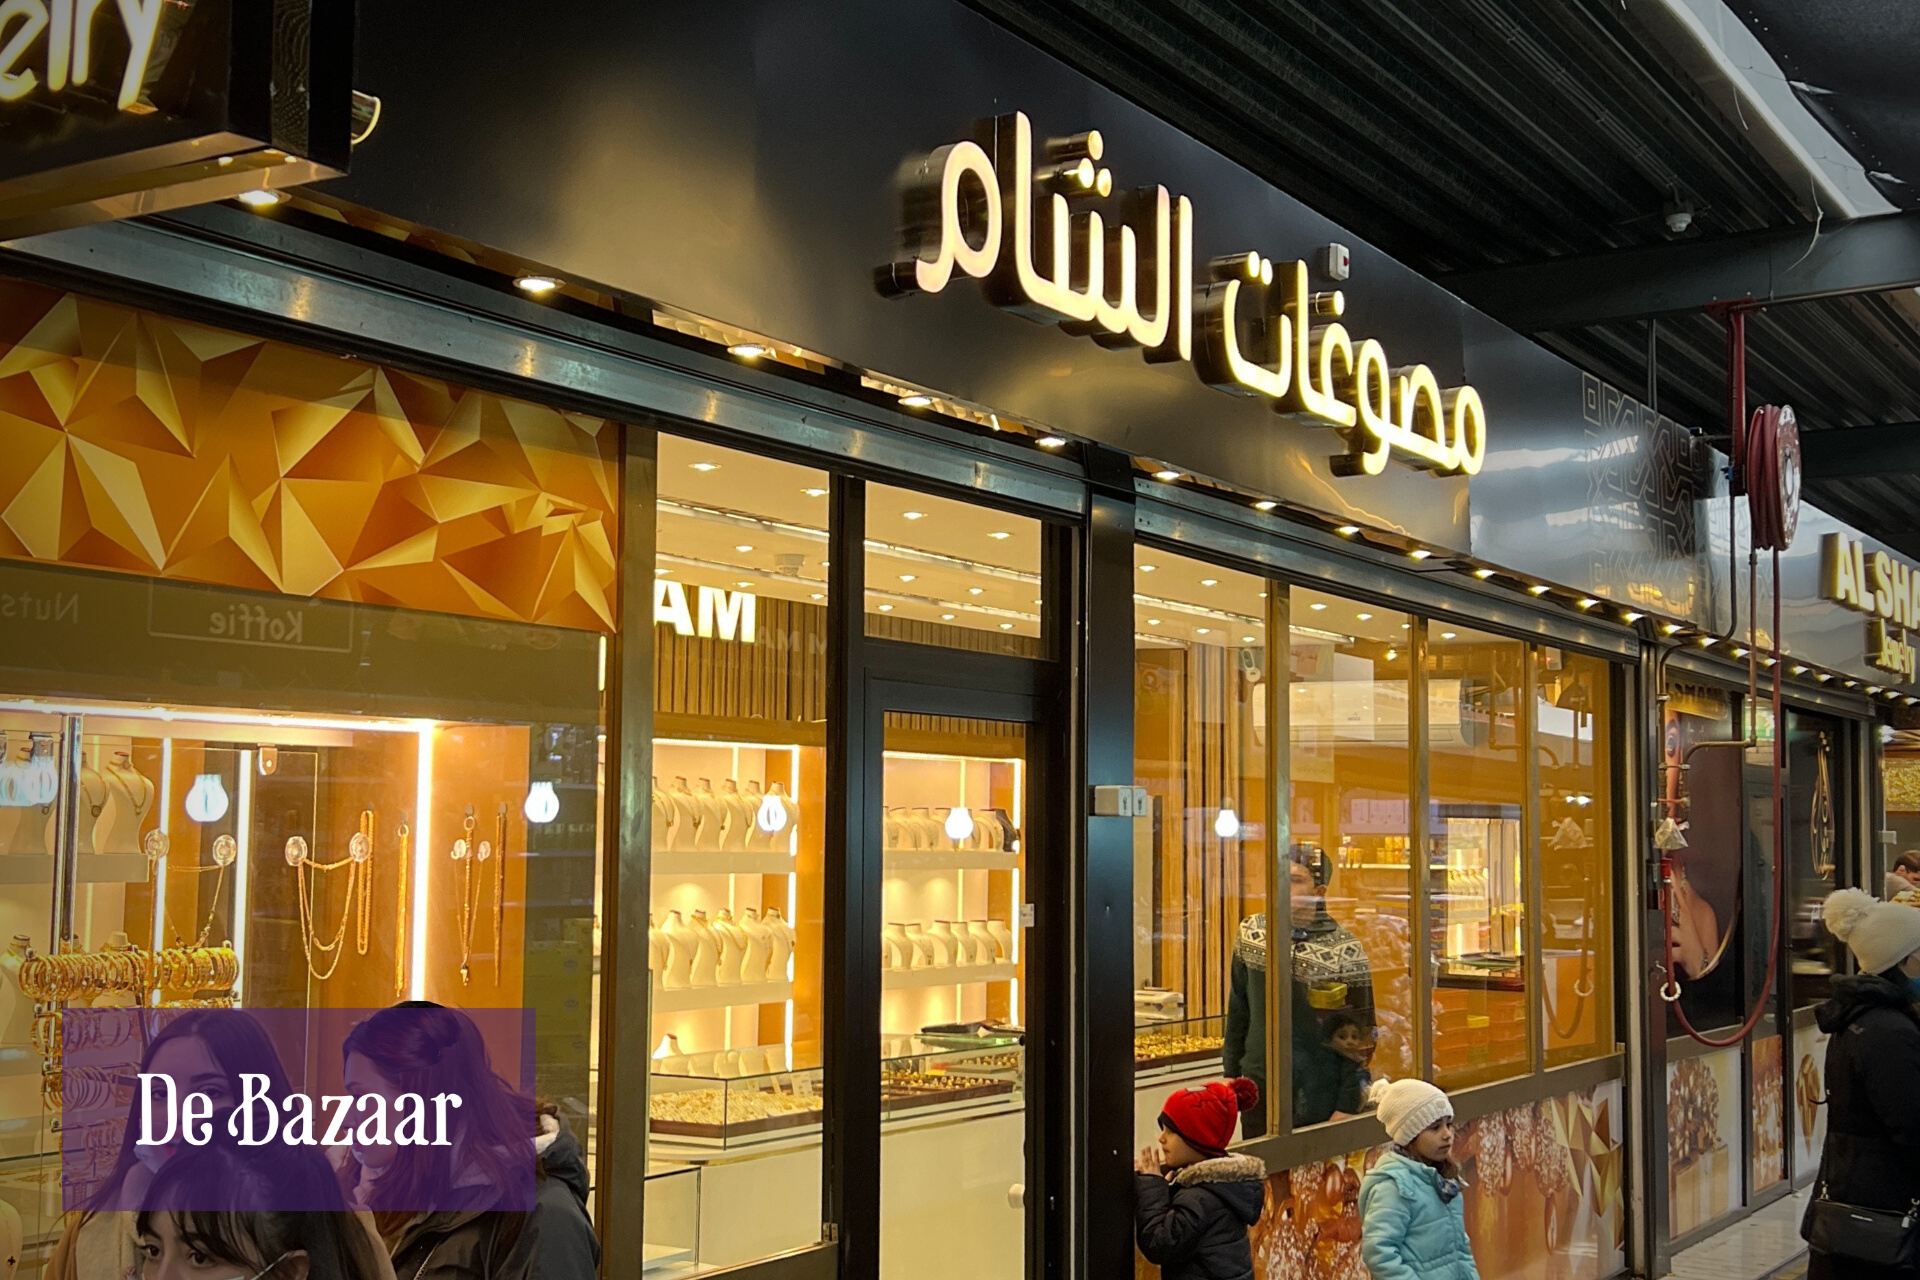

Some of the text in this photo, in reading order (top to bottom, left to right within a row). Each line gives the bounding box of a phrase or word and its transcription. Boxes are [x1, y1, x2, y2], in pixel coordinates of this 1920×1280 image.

[916, 110, 1486, 476] مصوغات الشام
[654, 578, 757, 643] AM
[1836, 531, 1875, 613] AL
